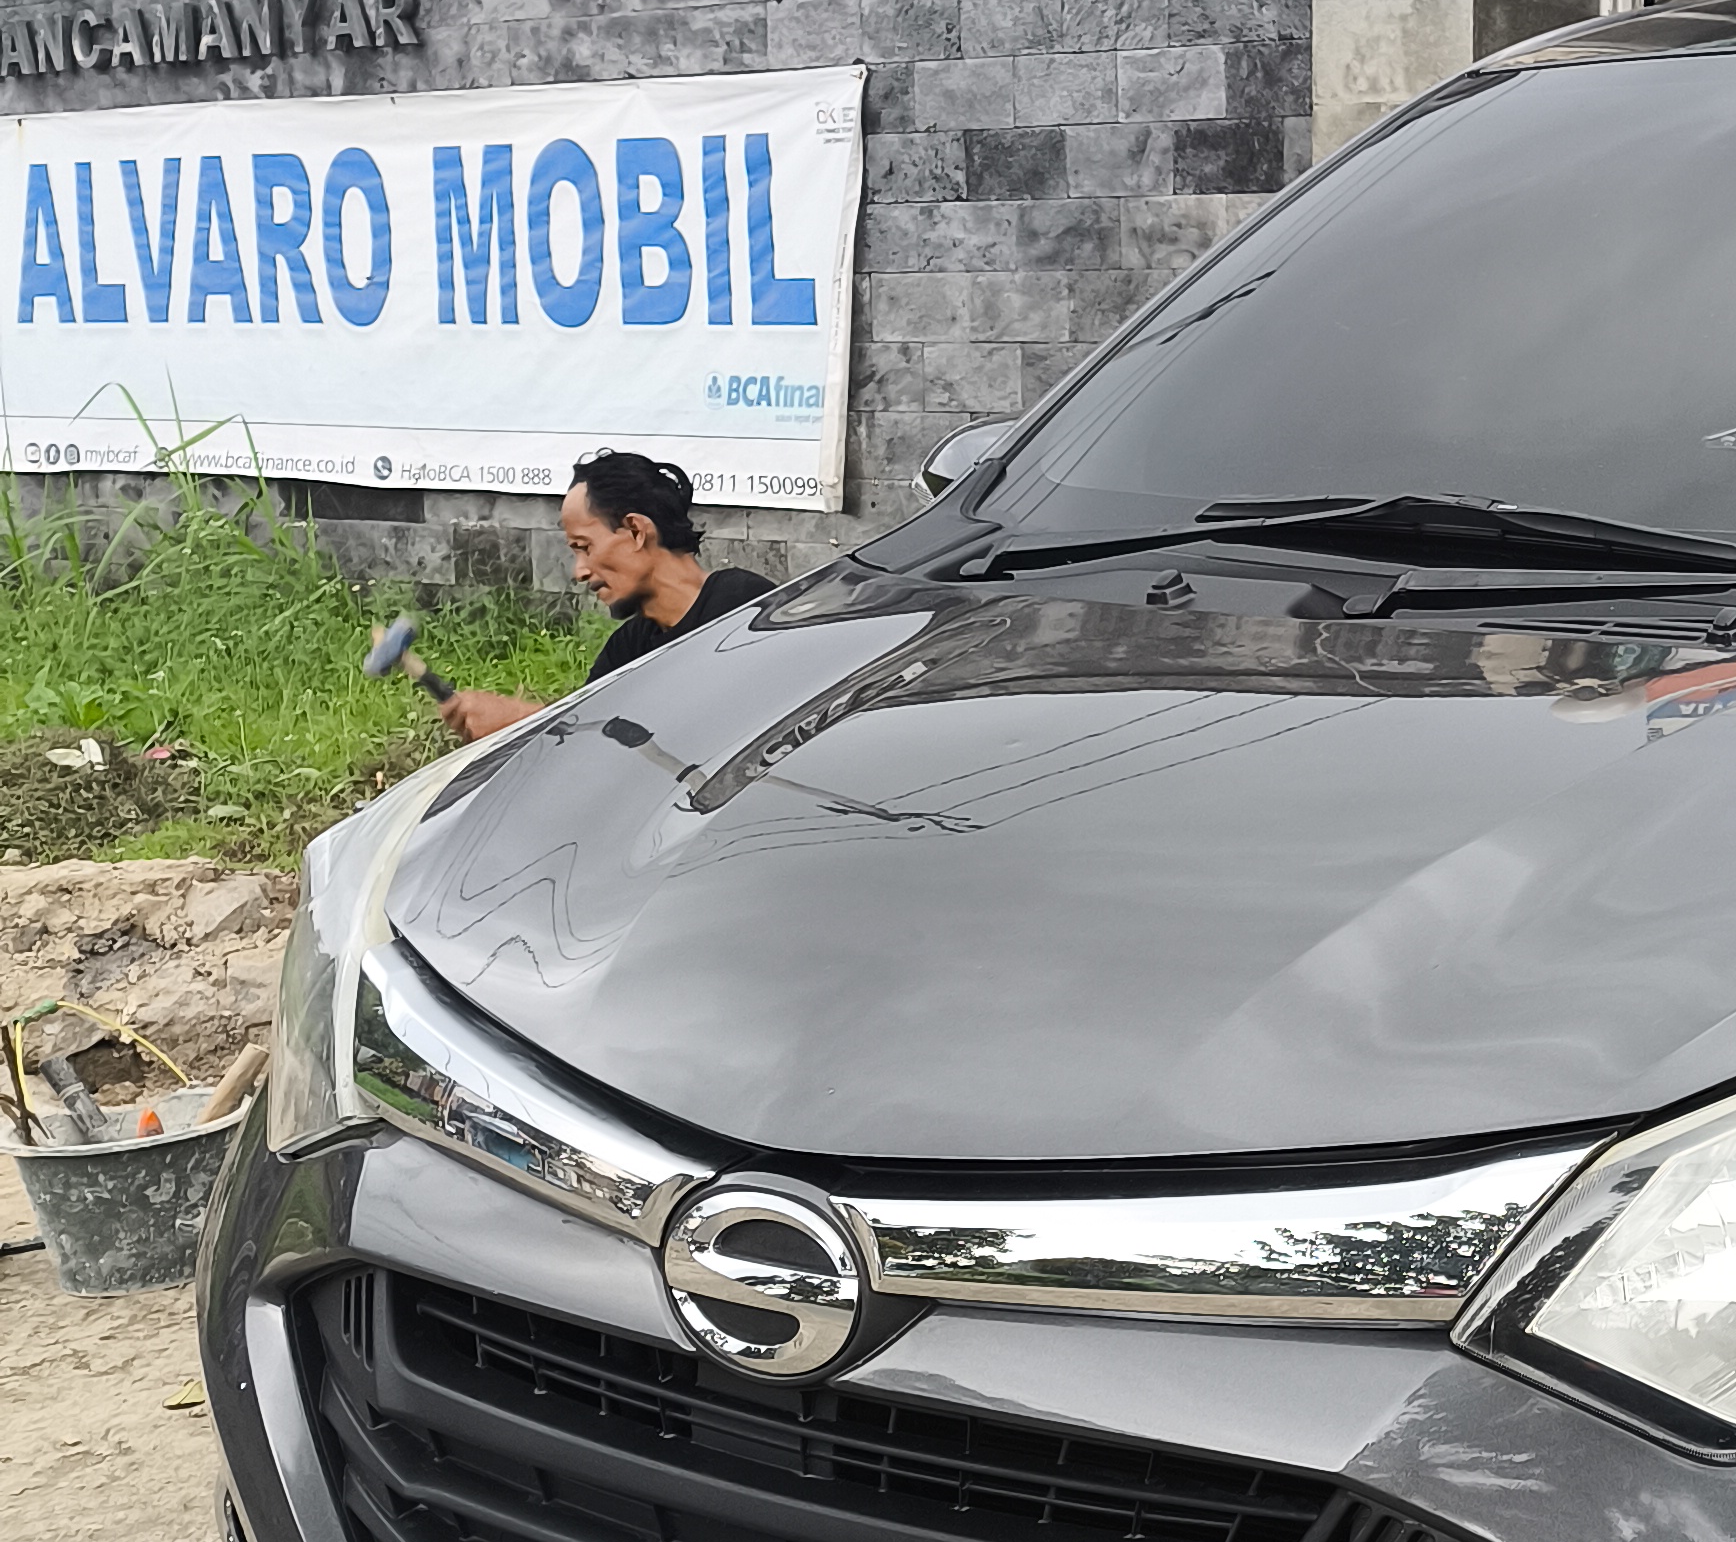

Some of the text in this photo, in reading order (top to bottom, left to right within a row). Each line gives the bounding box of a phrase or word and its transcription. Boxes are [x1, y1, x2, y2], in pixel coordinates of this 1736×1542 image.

[17, 132, 819, 328] ALVARO MOBIL
[85, 444, 140, 469] mybcaf
[478, 465, 516, 485] 1500
[521, 467, 552, 486] 888
[692, 472, 737, 492] 0811
